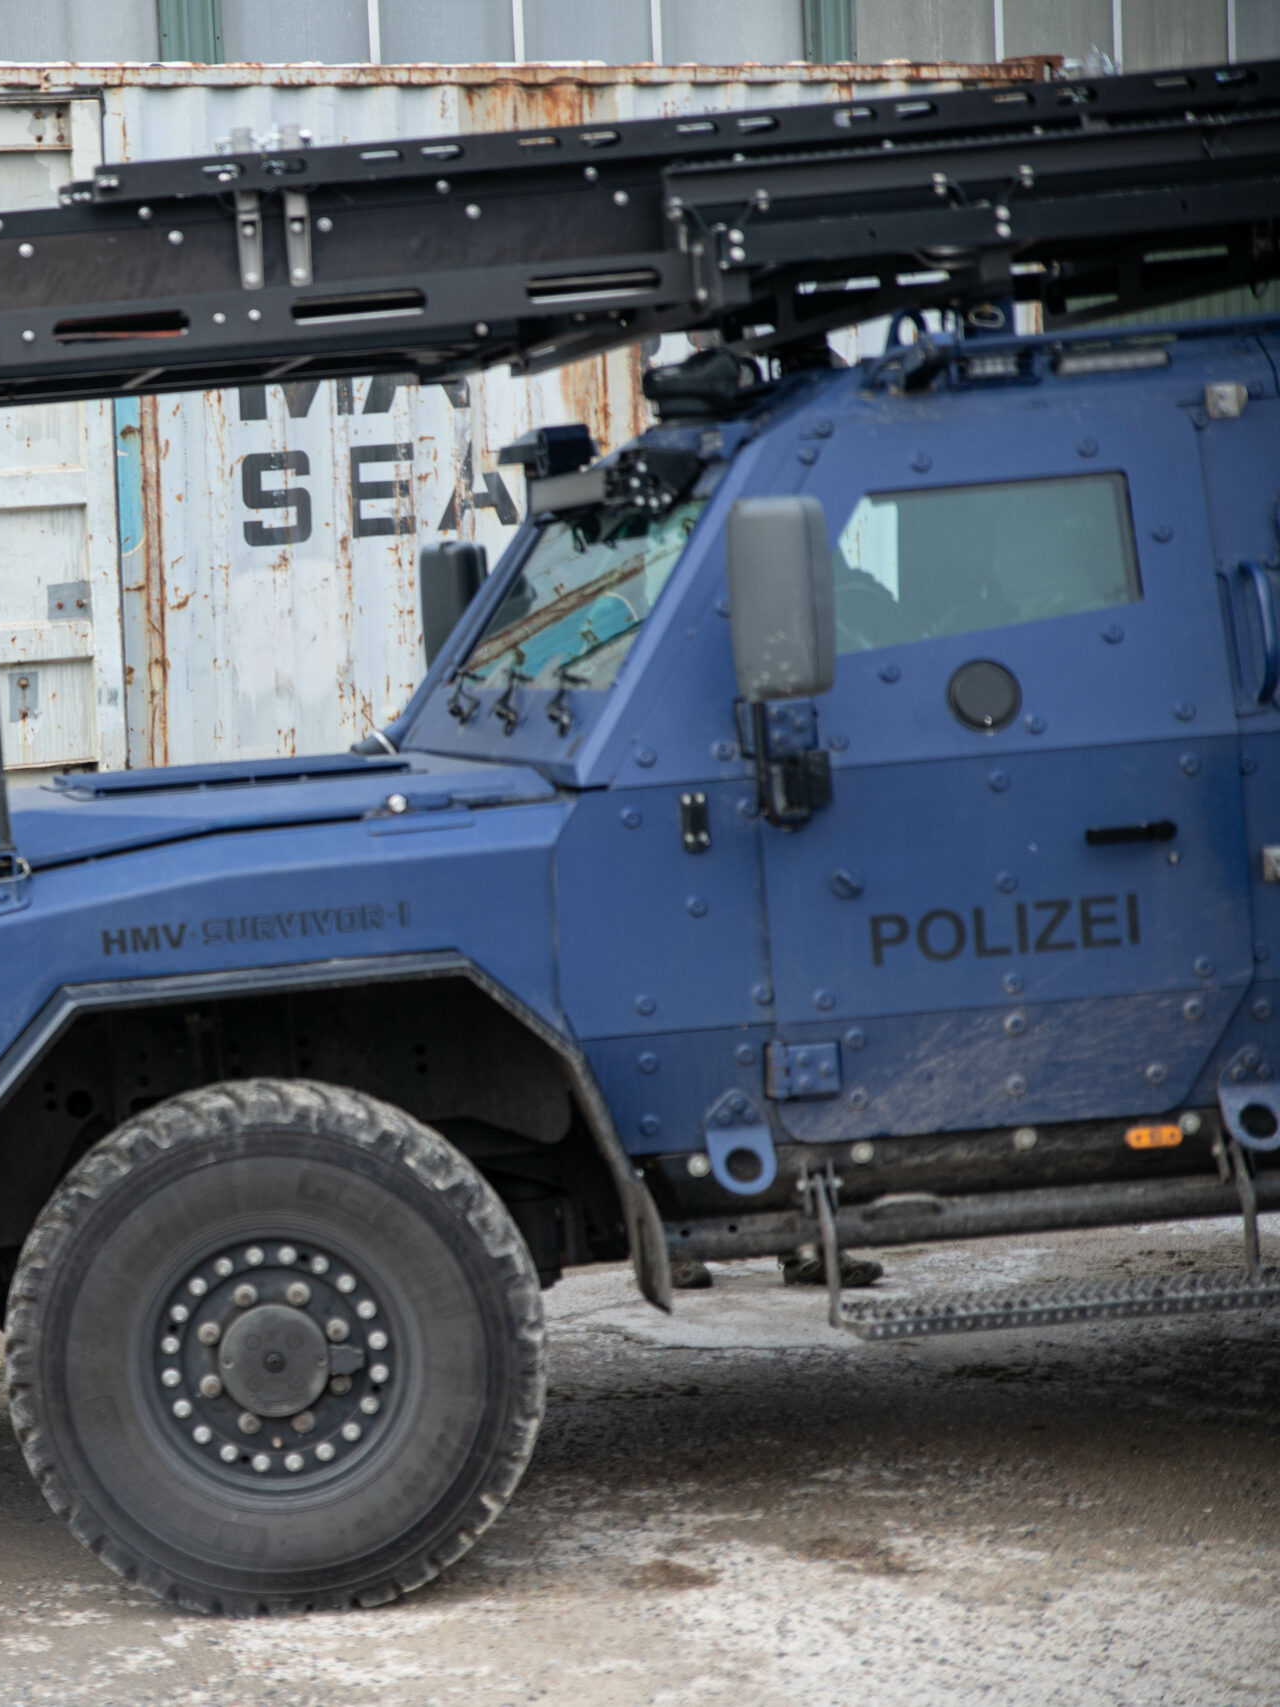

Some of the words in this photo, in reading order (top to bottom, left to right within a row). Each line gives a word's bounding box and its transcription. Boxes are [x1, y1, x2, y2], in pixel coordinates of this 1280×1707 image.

[242, 439, 520, 547] SEA
[101, 922, 187, 957] HMV
[201, 904, 386, 947] SURVIVOR
[870, 893, 1141, 968] POLIZEI
